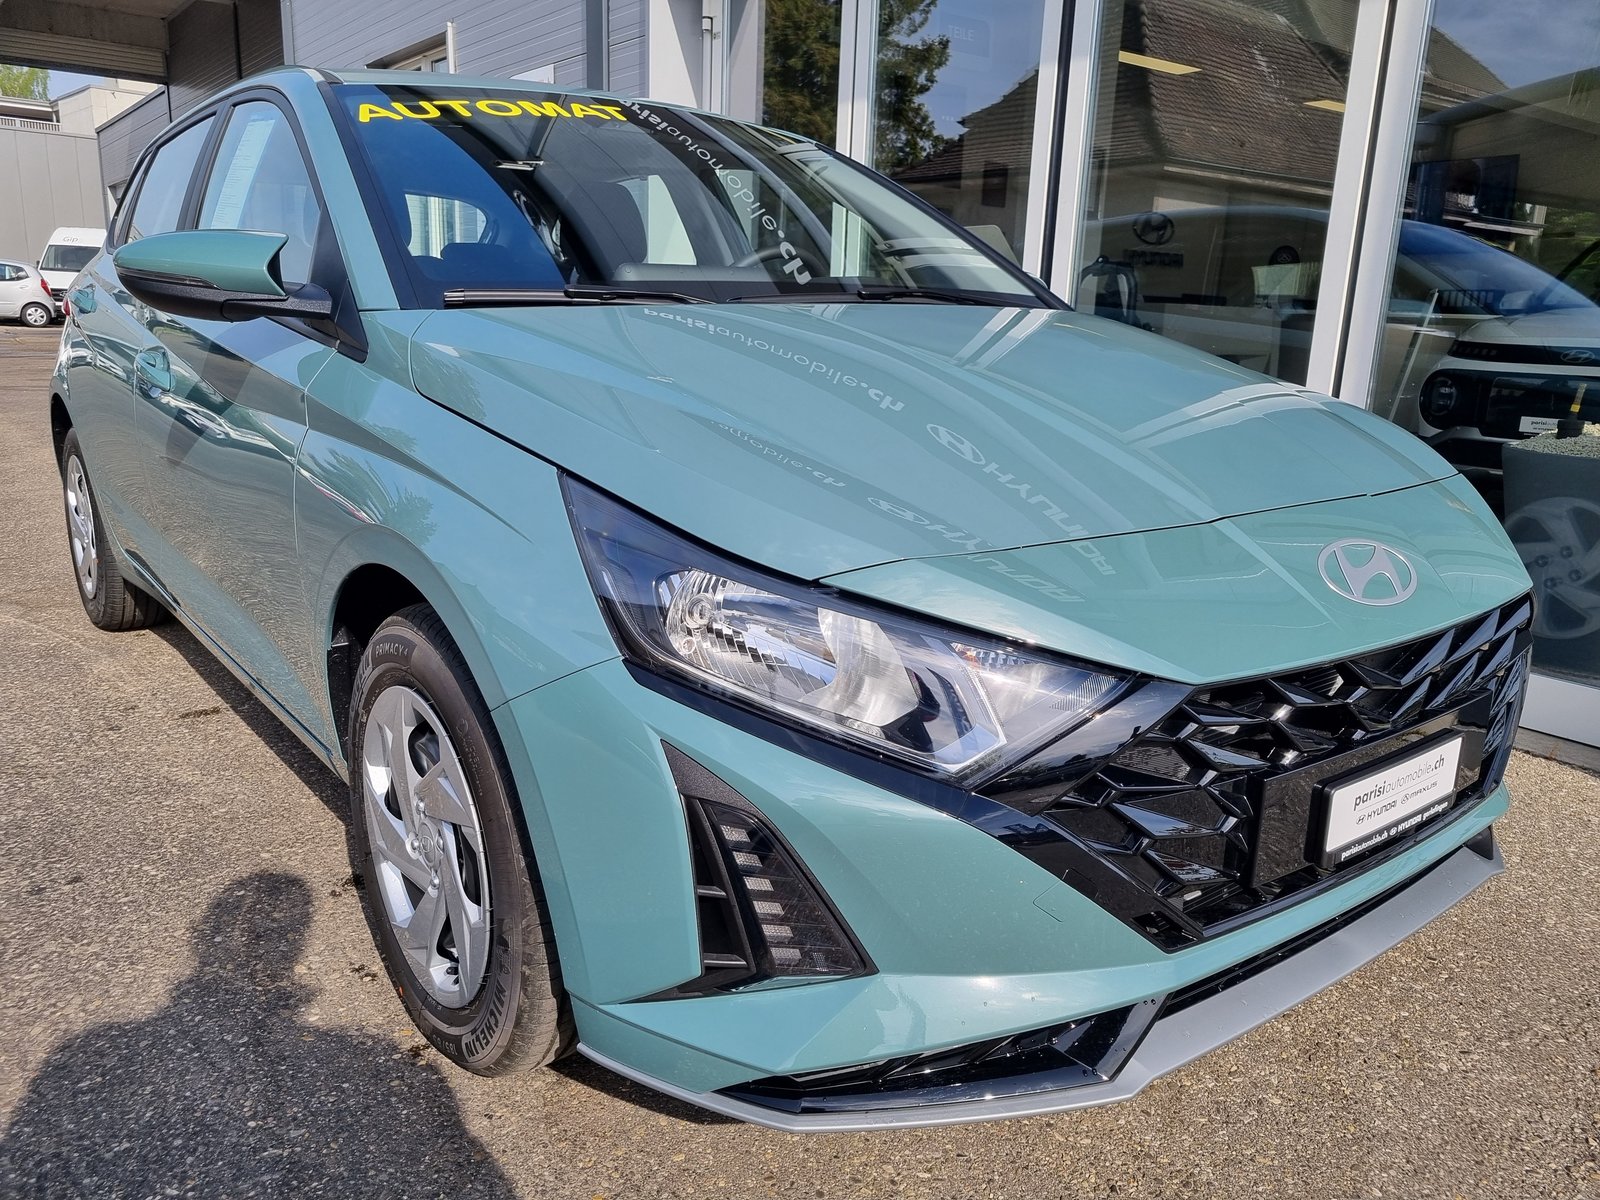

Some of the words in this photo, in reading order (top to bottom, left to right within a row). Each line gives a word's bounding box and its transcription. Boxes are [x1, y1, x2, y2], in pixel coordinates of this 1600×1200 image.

[357, 99, 628, 123] AUTOMAT
[375, 642, 404, 657] PRIMACY
[1353, 754, 1445, 812] parisiautomobile.ch
[1366, 800, 1398, 822] HYUNDAI
[1341, 830, 1388, 862] parisiautomobile.ch
[1398, 814, 1422, 833] HYUNDAI
[464, 977, 507, 1059] MICHELIN
